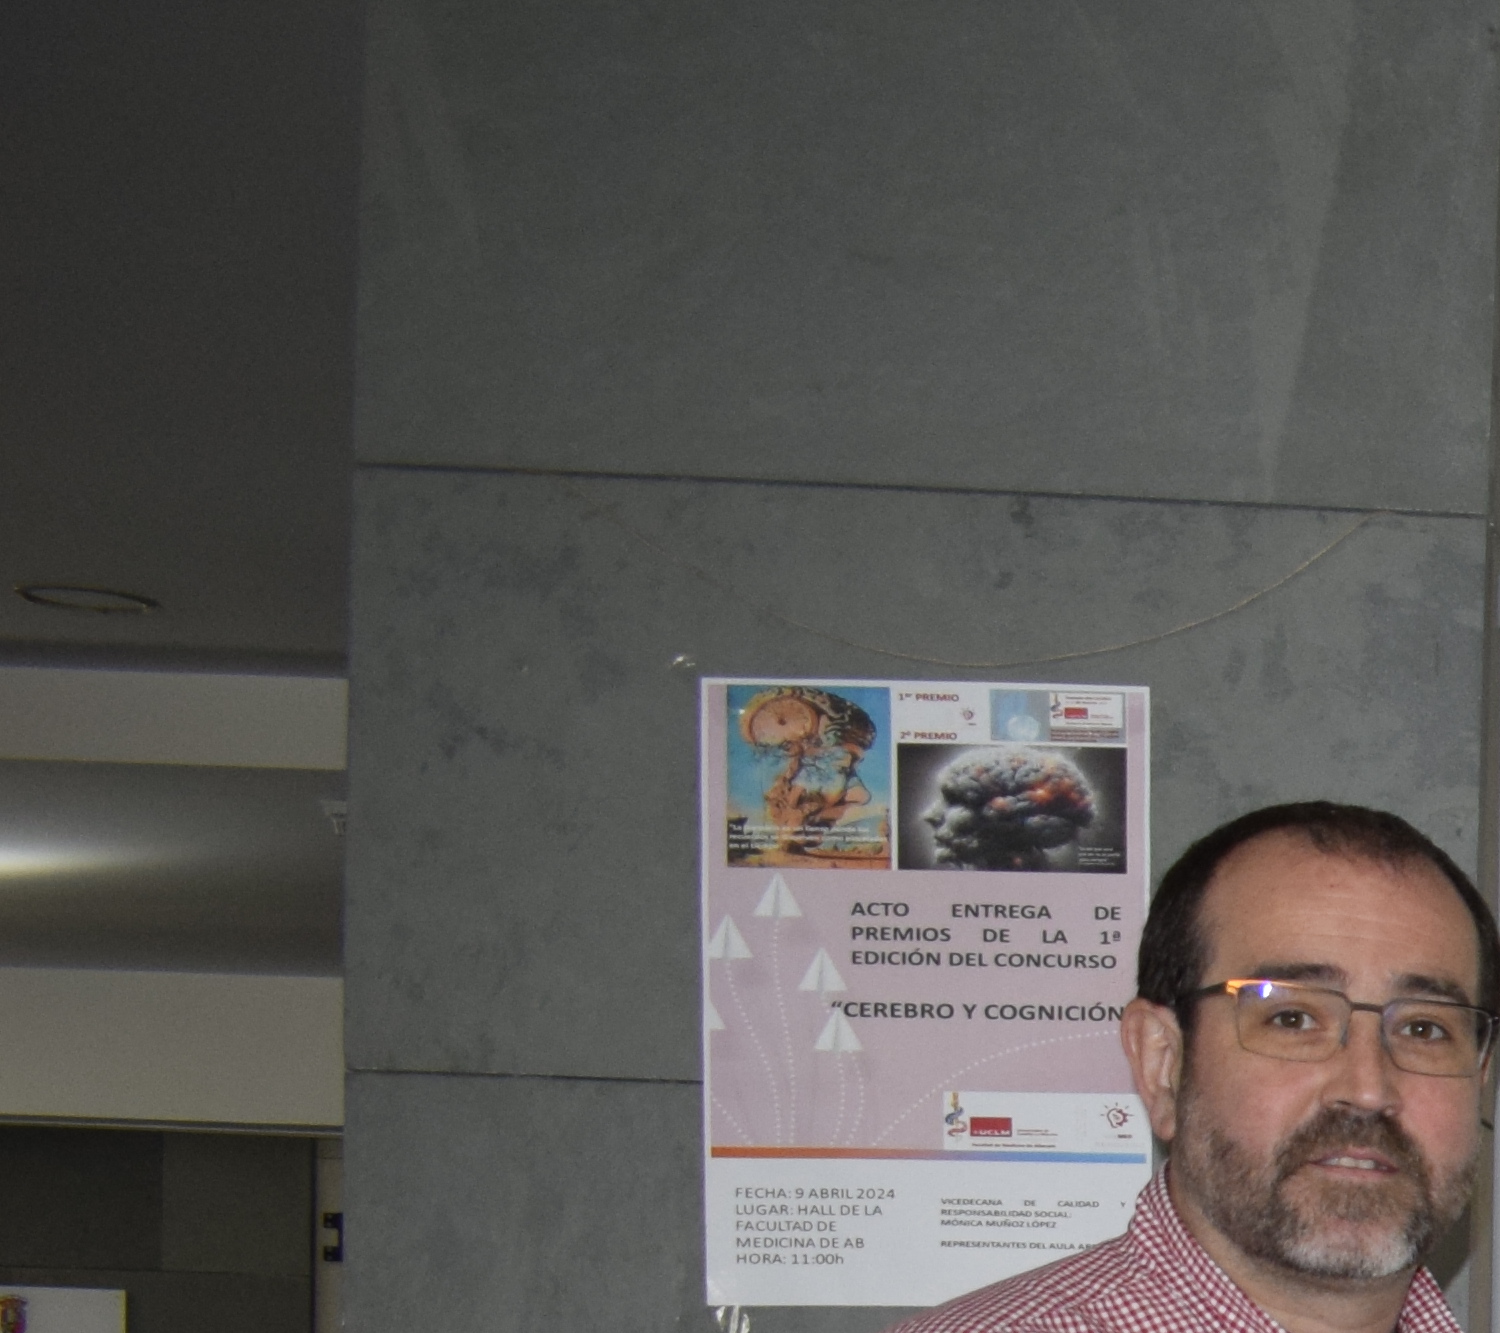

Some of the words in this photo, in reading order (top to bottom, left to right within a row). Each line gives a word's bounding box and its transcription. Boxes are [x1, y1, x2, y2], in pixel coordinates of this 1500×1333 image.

[915, 694, 959, 702] PREMIO
[914, 732, 957, 740] PREMIO
[850, 902, 910, 917] ACTO
[952, 904, 1051, 919] ENTREGA
[1094, 906, 1122, 920] DE
[851, 927, 951, 942] PREMIOS
[982, 929, 1010, 943] DE
[1042, 930, 1068, 944] LA
[1100, 931, 1121, 945] 1ª
[851, 948, 941, 966] EDICIÓN
[949, 953, 988, 967] DEL
[994, 953, 1117, 969] CONCURSO
[963, 1004, 977, 1020] Y
[984, 1002, 1124, 1022] COGNICIÓN
[735, 1187, 792, 1199] FECHA:
[795, 1188, 804, 1199] 9
[808, 1188, 853, 1199] ABRIL
[857, 1188, 895, 1200] 2024
[941, 1198, 1002, 1206] VICEDECANA
[736, 1204, 793, 1216] LUGAR:
[797, 1205, 836, 1216] HALL
[840, 1205, 860, 1216] DE
[865, 1205, 883, 1216] LA
[941, 1209, 1032, 1217] RESPONSABILIDAD
[736, 1220, 813, 1232] FACULTAD
[817, 1221, 837, 1232] DE
[736, 1237, 816, 1249] MEDICINA
[820, 1238, 839, 1249] DE
[844, 1238, 864, 1249] AB
[941, 1240, 1027, 1249] REPRESENTANTES
[736, 1253, 786, 1265] HORA:
[791, 1253, 844, 1265] 11:00h
